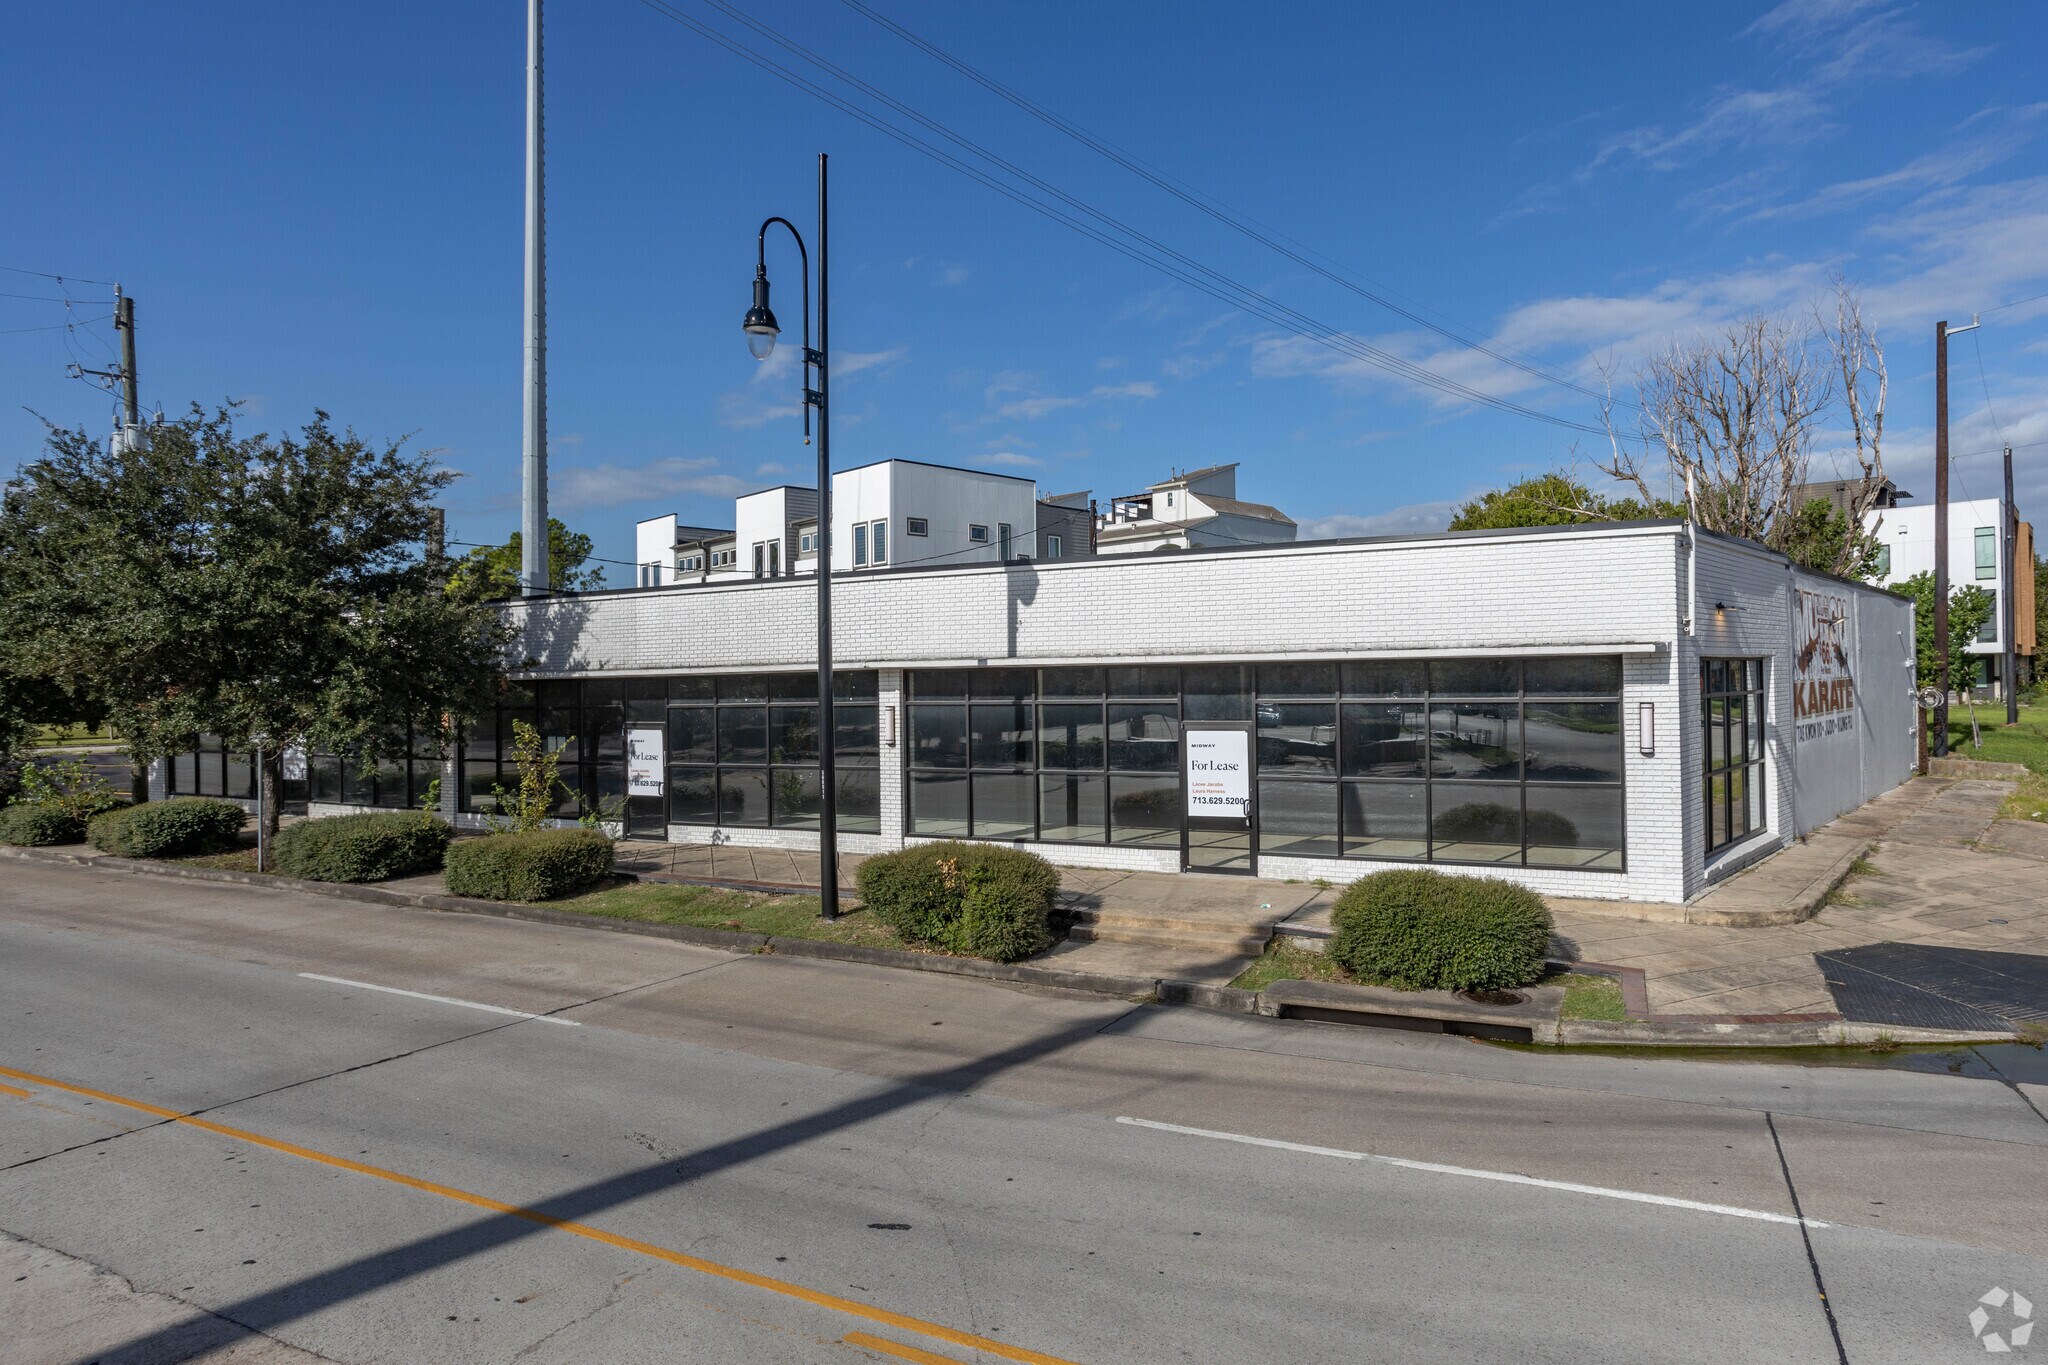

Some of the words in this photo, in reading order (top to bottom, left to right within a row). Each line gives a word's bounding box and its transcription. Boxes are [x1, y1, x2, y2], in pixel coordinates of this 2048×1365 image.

[1793, 678, 1854, 718] KARATE
[641, 752, 659, 760] Lease
[1191, 760, 1208, 771] For
[1210, 760, 1239, 771] Lease
[1192, 796, 1244, 805] 713.629.5200
